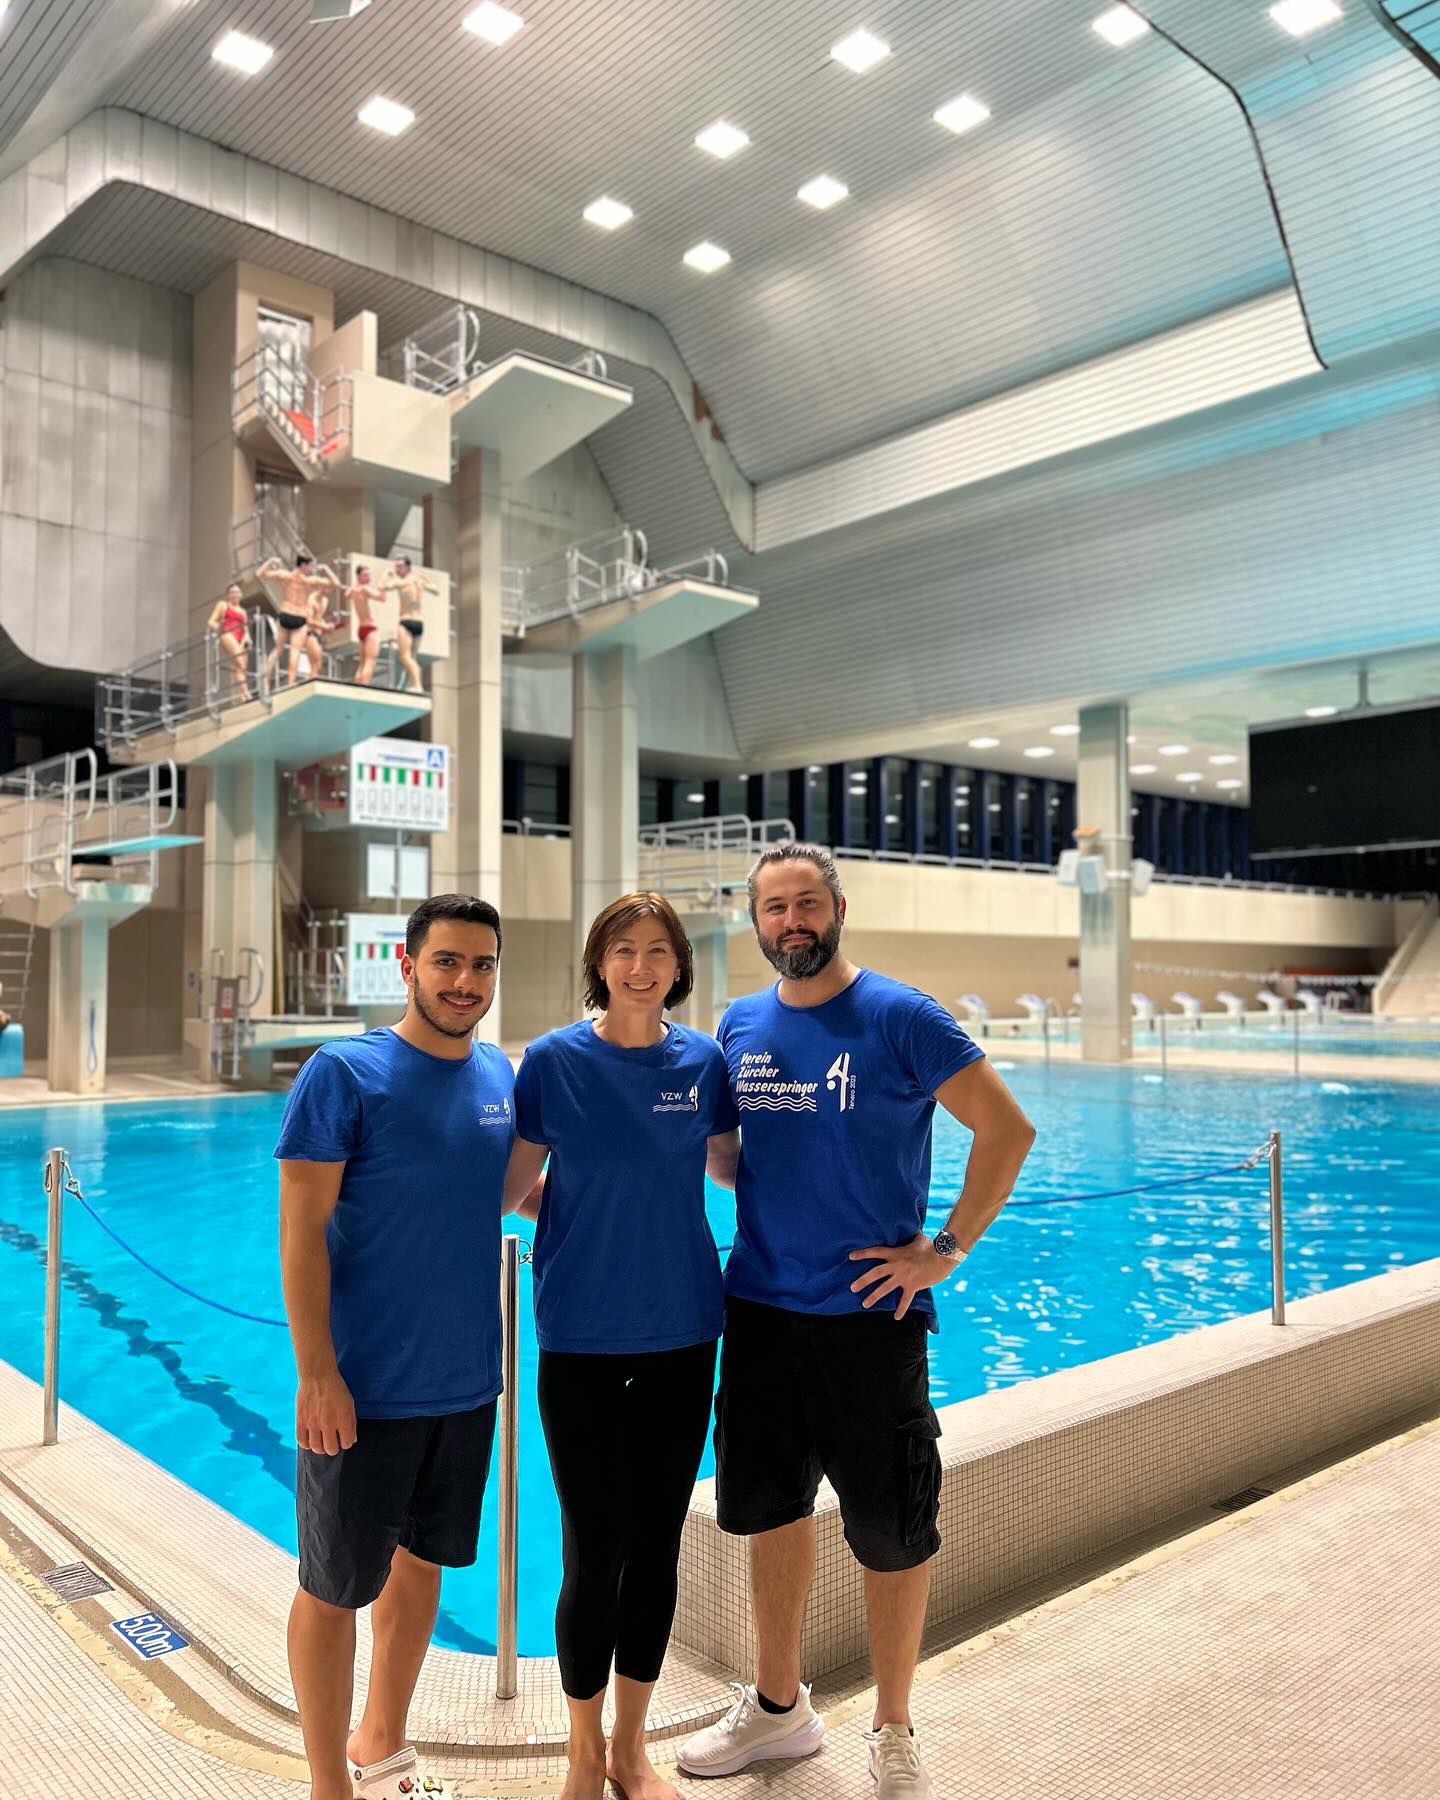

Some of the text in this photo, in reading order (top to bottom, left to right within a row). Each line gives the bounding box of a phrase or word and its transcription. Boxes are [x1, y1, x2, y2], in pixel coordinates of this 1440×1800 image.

[740, 1051, 771, 1064] Verein
[737, 1065, 779, 1078] Zürcher
[736, 1080, 818, 1097] Wasserspringer
[661, 1092, 683, 1101] VZW
[482, 1104, 500, 1113] VZW
